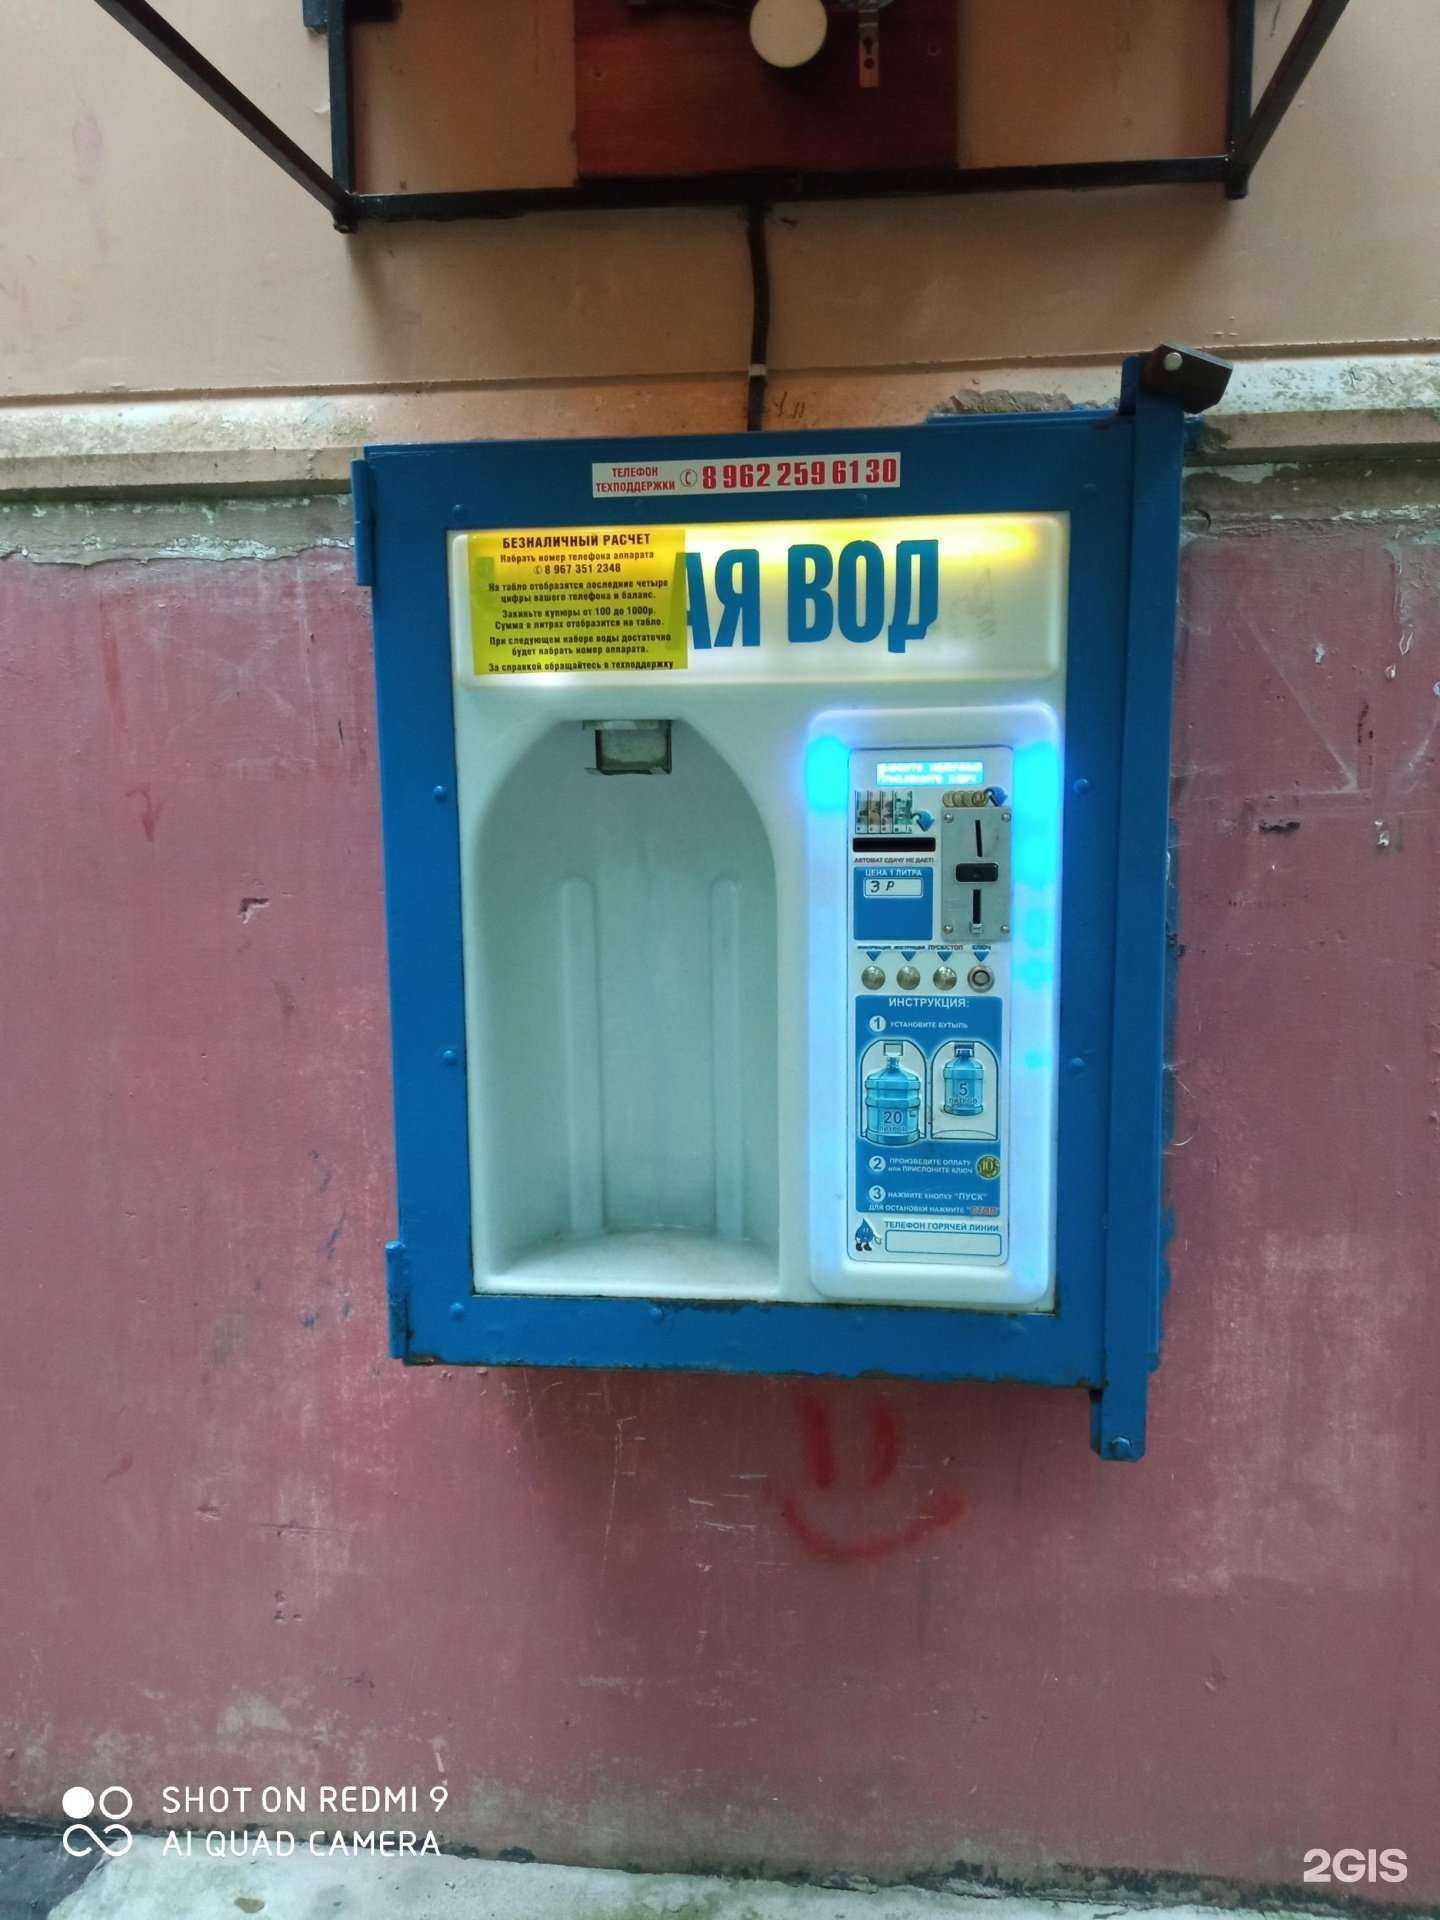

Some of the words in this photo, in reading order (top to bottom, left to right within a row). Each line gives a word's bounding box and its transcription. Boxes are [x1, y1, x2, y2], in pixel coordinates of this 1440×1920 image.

[612, 466, 658, 478] ТЕЛЕФОН
[702, 465, 717, 490] 8
[722, 462, 771, 488] 962
[777, 462, 825, 486] 259
[596, 480, 676, 494] ТЕХПОДДЕРЖКИ
[502, 535, 599, 549] БЕЗНАЛИЧНЫЙ
[603, 533, 651, 546] РАСЧЕТ
[500, 554, 536, 564] Набрать
[538, 554, 566, 563] номер
[569, 552, 611, 562] телефона
[613, 552, 654, 561] аппарата
[544, 565, 551, 575] 8
[553, 564, 572, 574] 967
[575, 564, 593, 574] 351
[488, 583, 500, 592] На
[502, 582, 528, 591] табло
[529, 581, 584, 592] отобразятся
[586, 580, 635, 590] последние
[636, 579, 669, 589] четыре
[501, 594, 532, 604] цифры
[533, 592, 567, 602] вашего
[568, 591, 611, 602] телефона
[502, 609, 543, 618] Закиньте
[544, 608, 581, 618] купюры
[583, 607, 592, 616] от
[595, 607, 611, 616] 100
[613, 606, 624, 617] до
[495, 621, 524, 631] Сумма
[533, 621, 563, 630] литрах
[566, 618, 621, 629] отобразится
[623, 618, 634, 626] на
[489, 636, 506, 647] При
[508, 635, 561, 646] следующем
[562, 634, 594, 644] наборе
[596, 634, 619, 644] воды
[621, 633, 671, 643] достаточно
[511, 647, 536, 658] будет
[538, 646, 573, 657] набрать
[575, 645, 603, 656] номер
[488, 663, 499, 672] За
[501, 662, 542, 673] справкой
[544, 660, 602, 672] обращайтесь
[611, 659, 673, 670] техподдержку
[865, 869, 888, 877] ЦЕНА
[896, 869, 922, 877] ЛИТРА
[959, 1082, 968, 1096] 5
[883, 1110, 903, 1125] 20
[884, 1221, 925, 1230] ТЕЛЕФОН
[928, 1222, 966, 1231] ГОРЯЧЕЙ
[969, 1223, 1000, 1232] ЛИНИИ
